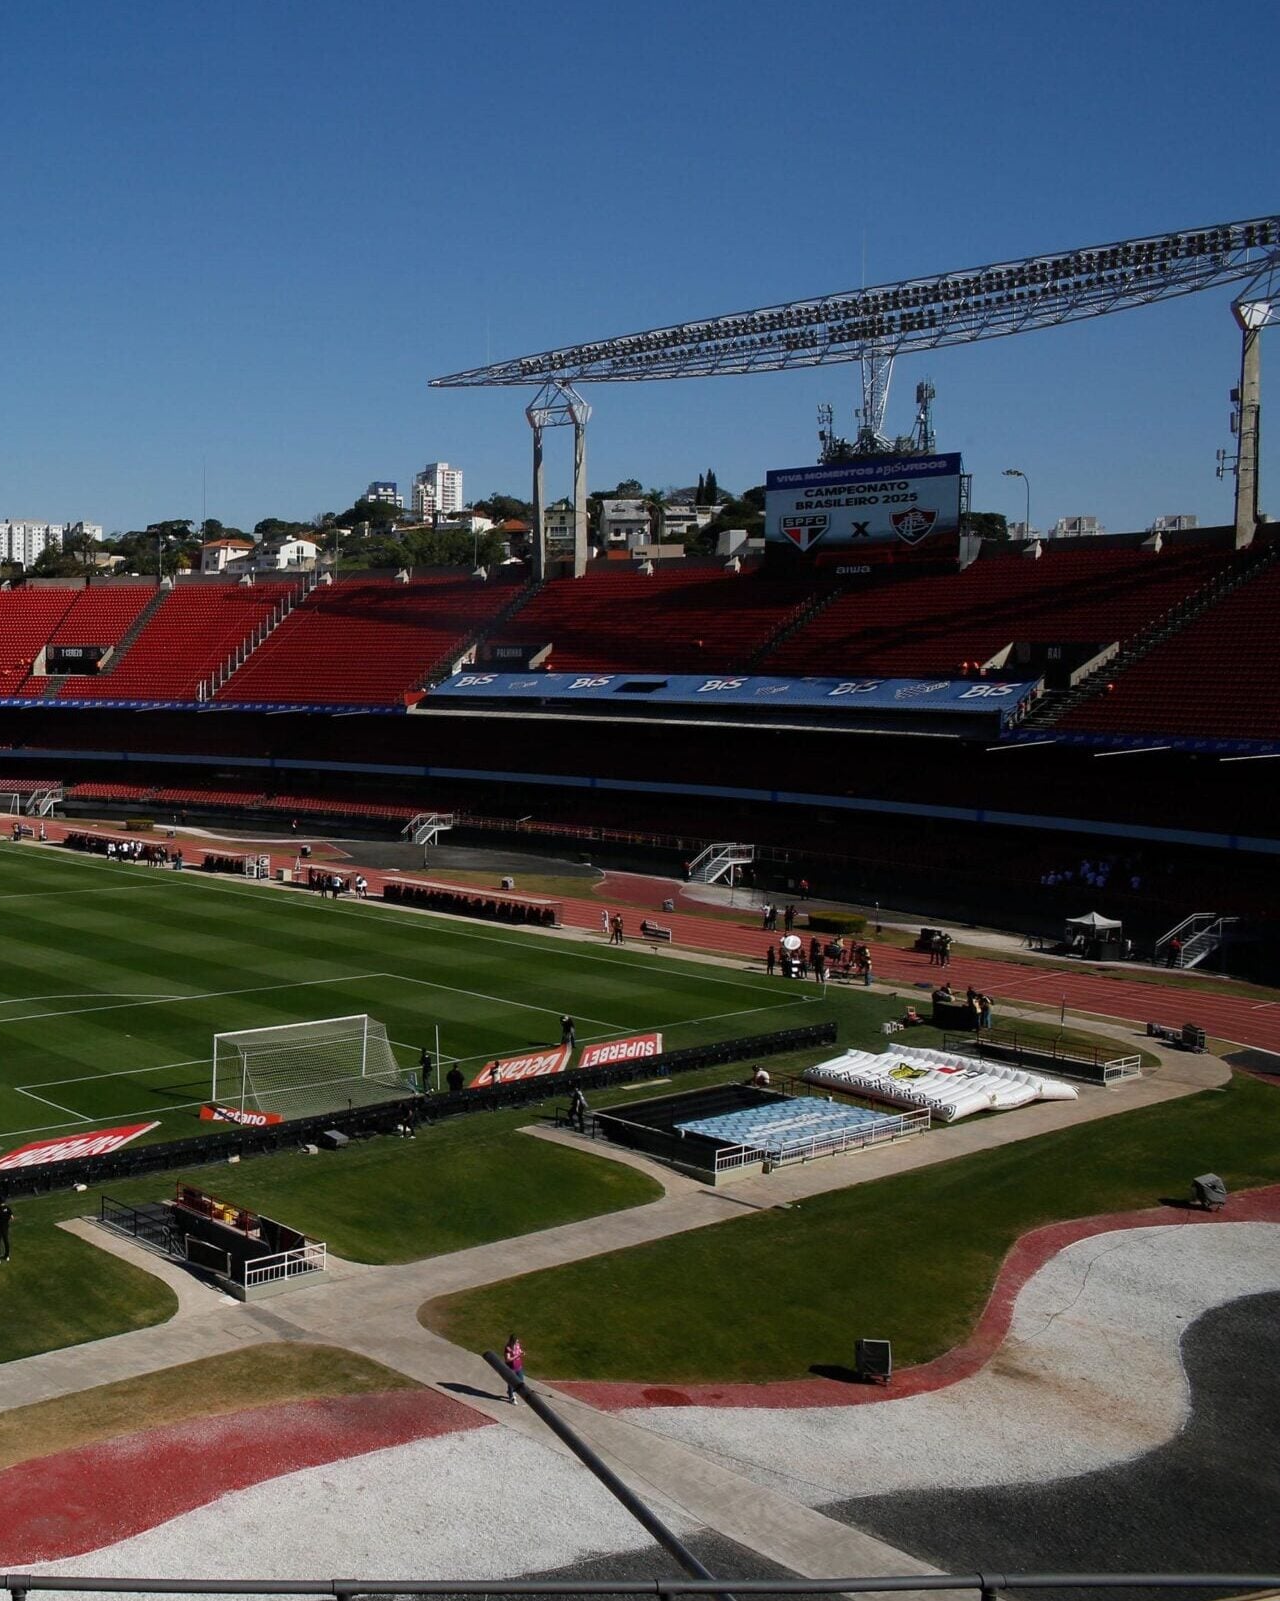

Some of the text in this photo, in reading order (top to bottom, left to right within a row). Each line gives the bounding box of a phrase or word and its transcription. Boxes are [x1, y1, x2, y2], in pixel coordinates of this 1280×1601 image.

[776, 475, 803, 483] VIVA
[804, 467, 874, 480] MOMENTOS
[804, 481, 910, 498] CAMPEONATO
[795, 492, 918, 511] BRASILEIRO 2025
[785, 516, 825, 526] SPFC
[835, 565, 871, 574] aiwa
[582, 1041, 656, 1067] SUPERBET
[212, 1107, 267, 1126] Betano
